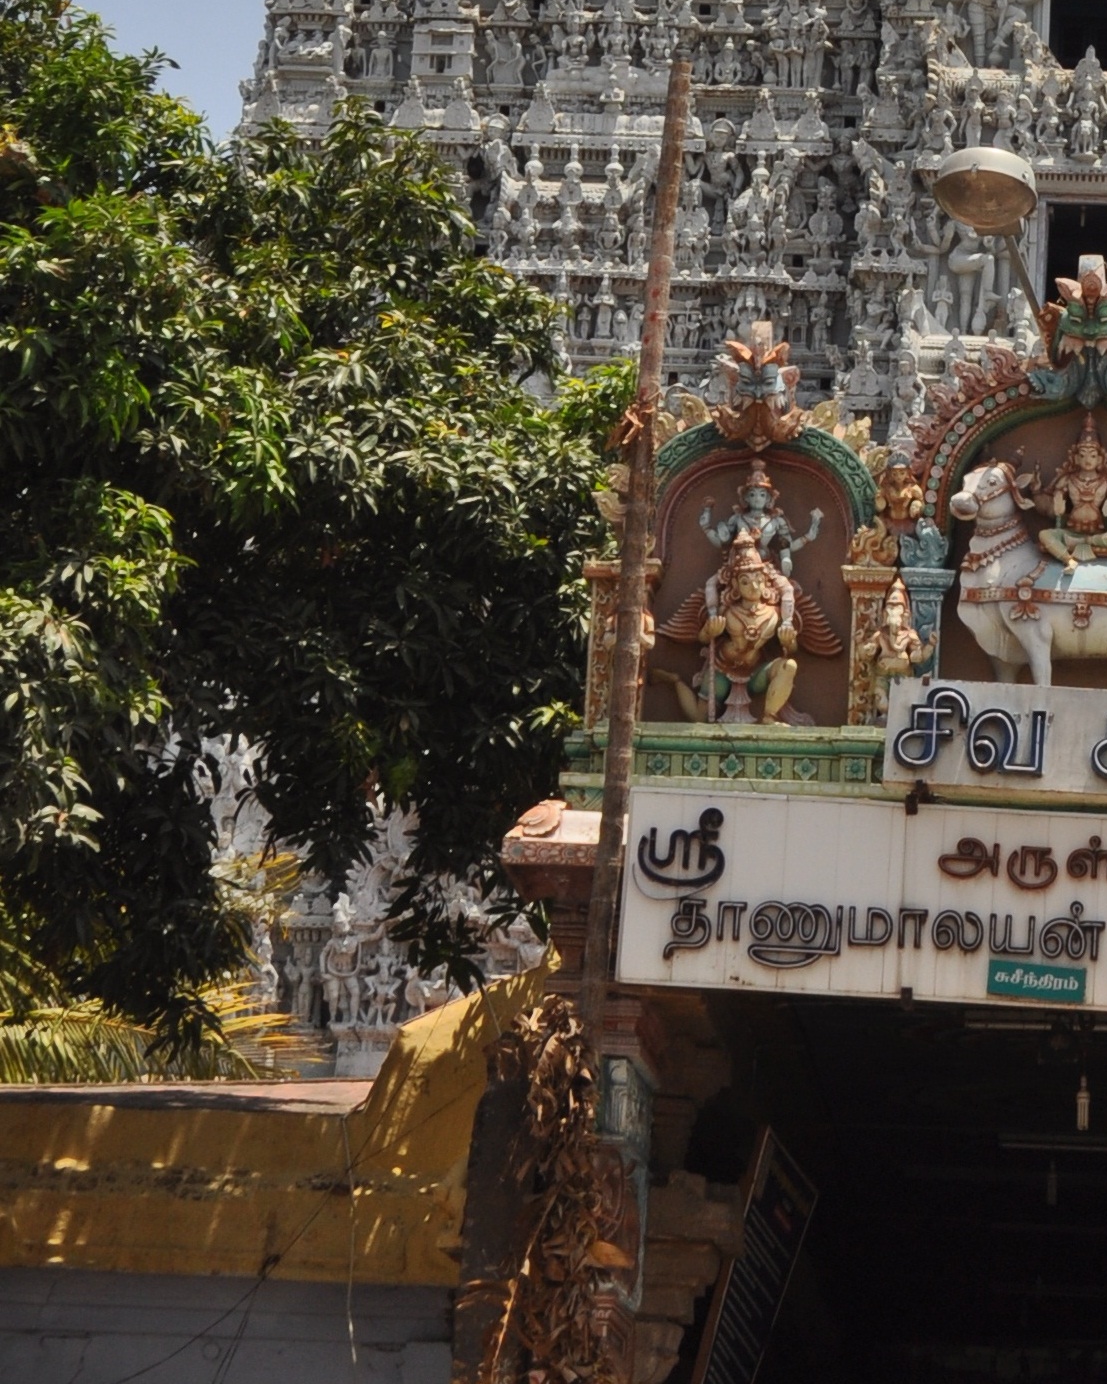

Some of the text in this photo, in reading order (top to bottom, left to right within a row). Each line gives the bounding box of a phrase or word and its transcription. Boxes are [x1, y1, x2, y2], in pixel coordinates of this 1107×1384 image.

[894, 687, 1047, 777] சிவ
[662, 897, 1106, 969] தாணுமாலயன்
[994, 968, 1079, 991] சுசீந்திரம்
